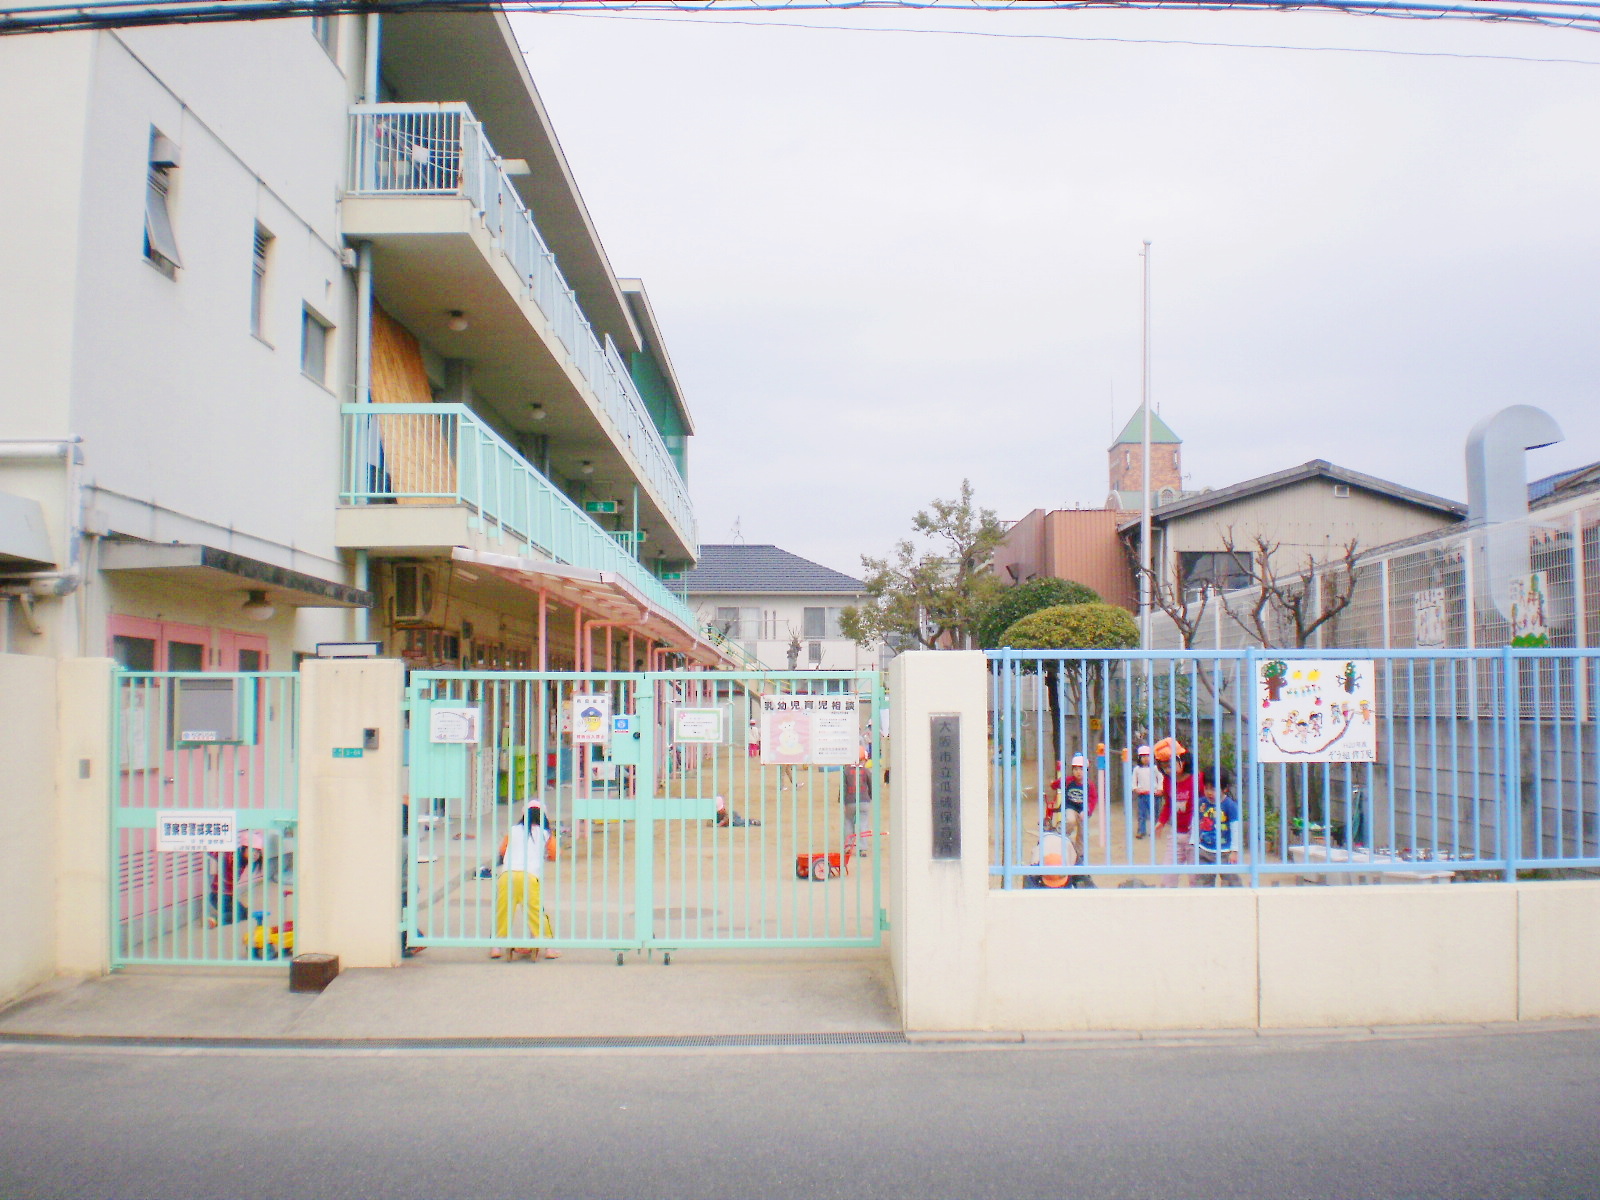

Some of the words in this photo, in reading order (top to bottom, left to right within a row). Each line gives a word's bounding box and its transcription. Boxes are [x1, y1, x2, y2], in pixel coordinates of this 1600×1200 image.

[764, 700, 855, 711] 乳幼児育児相談
[163, 822, 229, 836] 警察官警戒実施中
